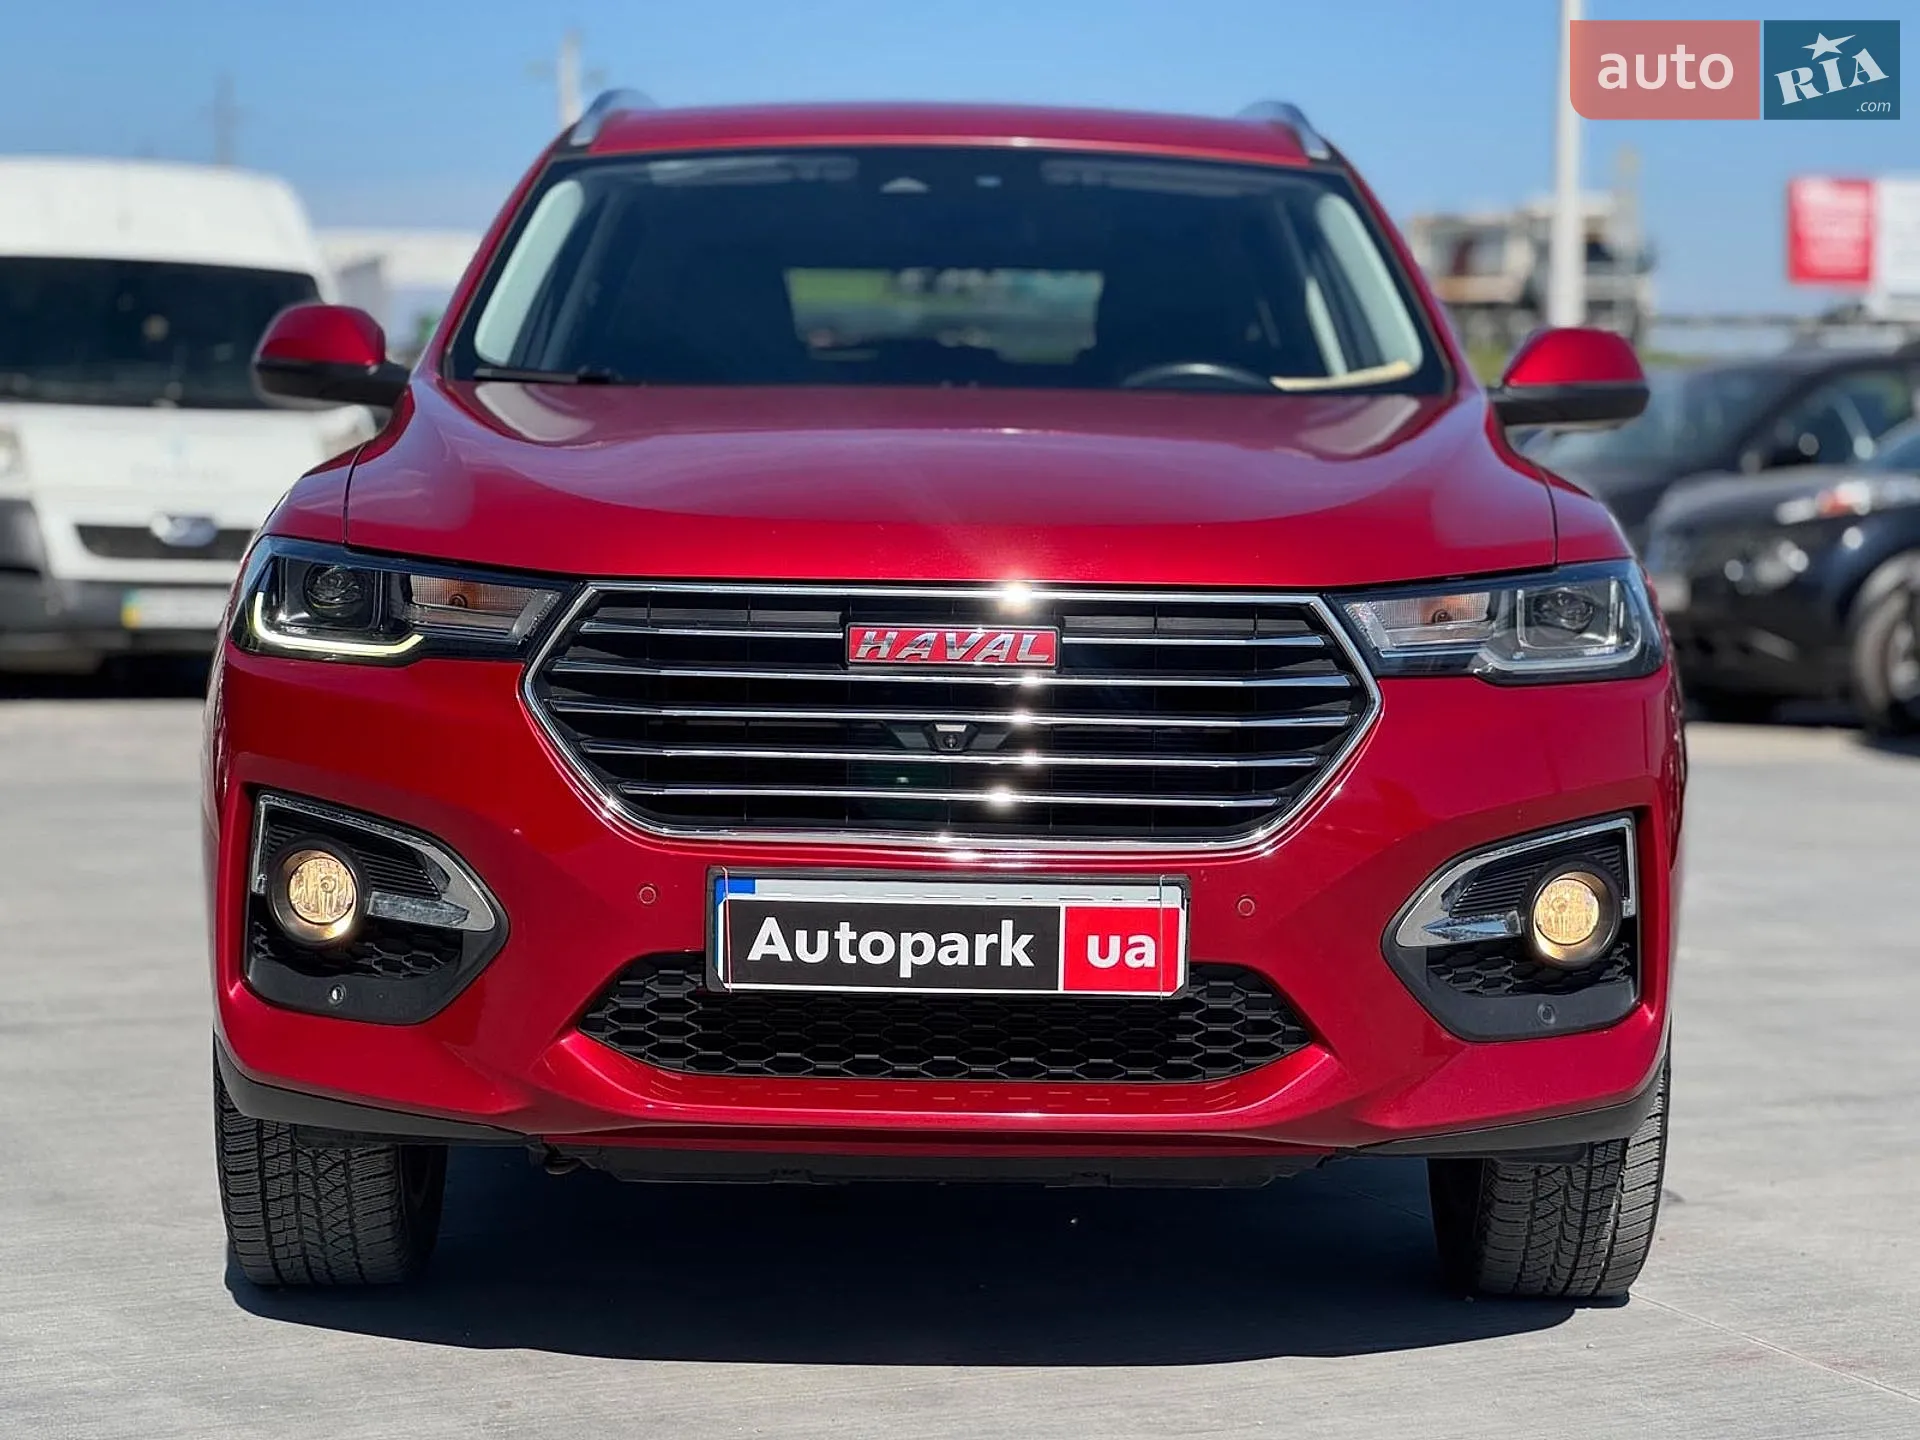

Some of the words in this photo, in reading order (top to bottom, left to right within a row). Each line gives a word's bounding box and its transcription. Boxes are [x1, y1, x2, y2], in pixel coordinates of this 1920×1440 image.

[855, 631, 1050, 662] HAVAL
[747, 917, 1035, 978] Autopark
[1086, 933, 1156, 969] ua
